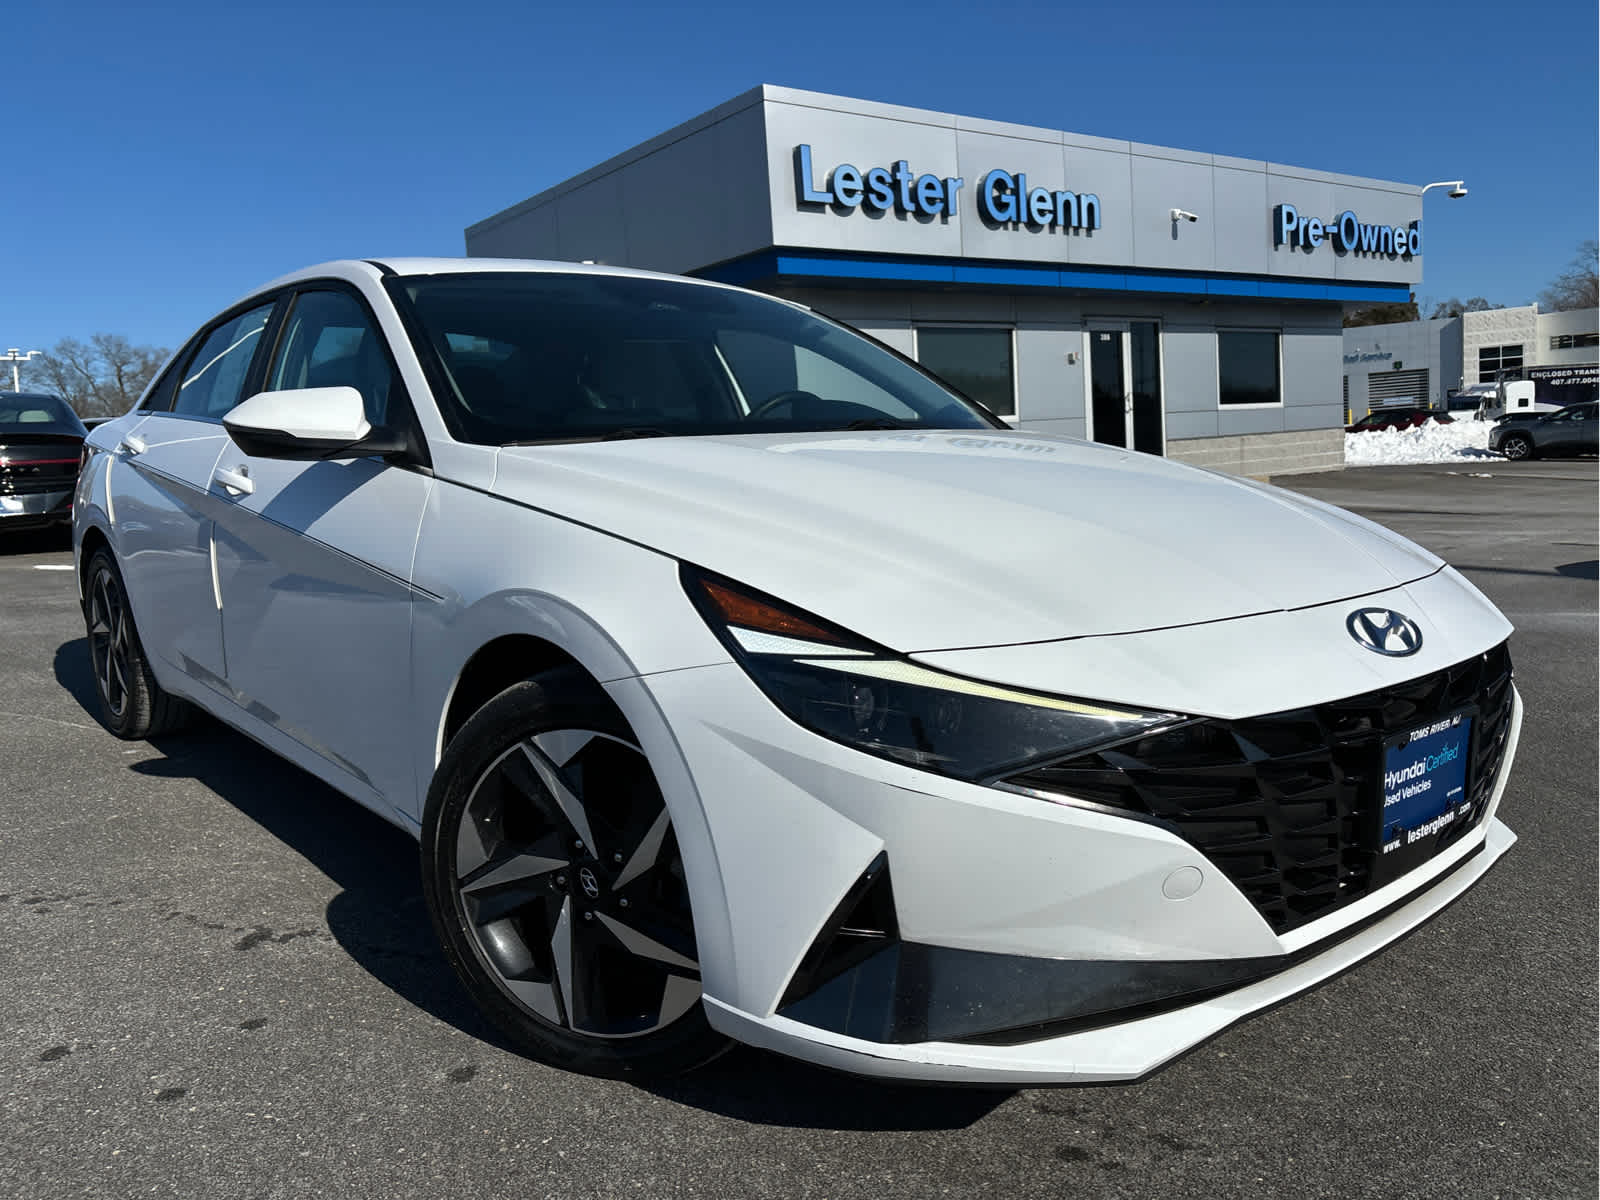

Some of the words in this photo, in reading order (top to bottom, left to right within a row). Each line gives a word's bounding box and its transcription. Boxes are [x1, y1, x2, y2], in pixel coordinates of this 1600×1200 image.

[794, 143, 964, 220] Lester
[978, 168, 1101, 233] Glenn
[1274, 203, 1422, 260] Pre-Owned
[1531, 370, 1573, 379] ENCLOSED
[1410, 726, 1430, 742] TOMS
[1451, 713, 1462, 726] NJ
[1384, 757, 1426, 790] Hyundai
[1426, 741, 1459, 772] Certified
[1402, 779, 1432, 800] Vehicles
[1408, 811, 1454, 844] lesterglenn
